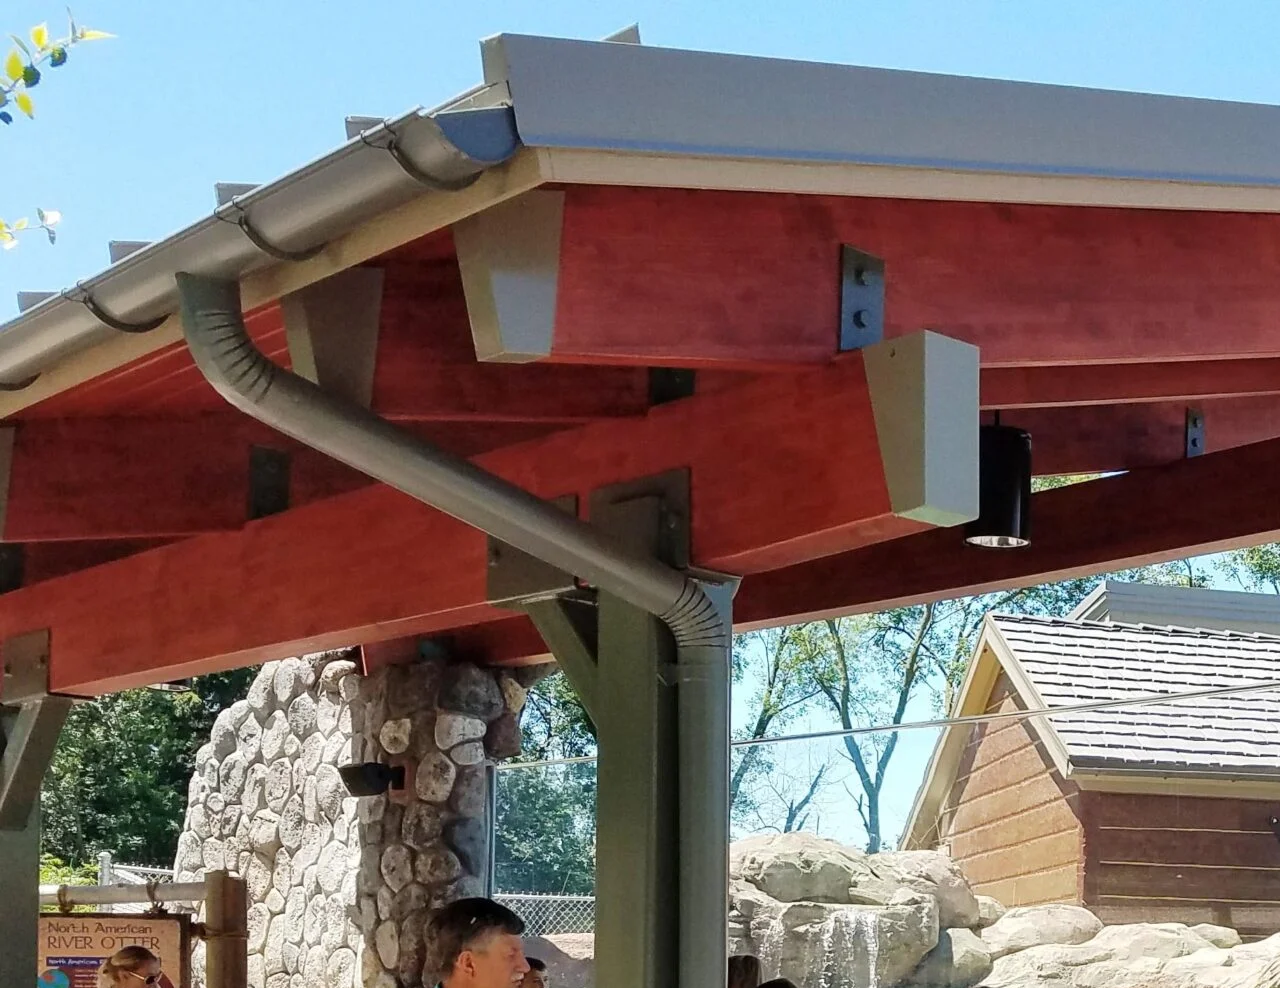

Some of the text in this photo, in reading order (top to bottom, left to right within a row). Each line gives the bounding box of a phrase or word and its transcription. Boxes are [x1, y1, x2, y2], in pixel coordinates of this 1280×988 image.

[48, 922, 152, 934] North American
[47, 936, 160, 949] RIVER OTTER
